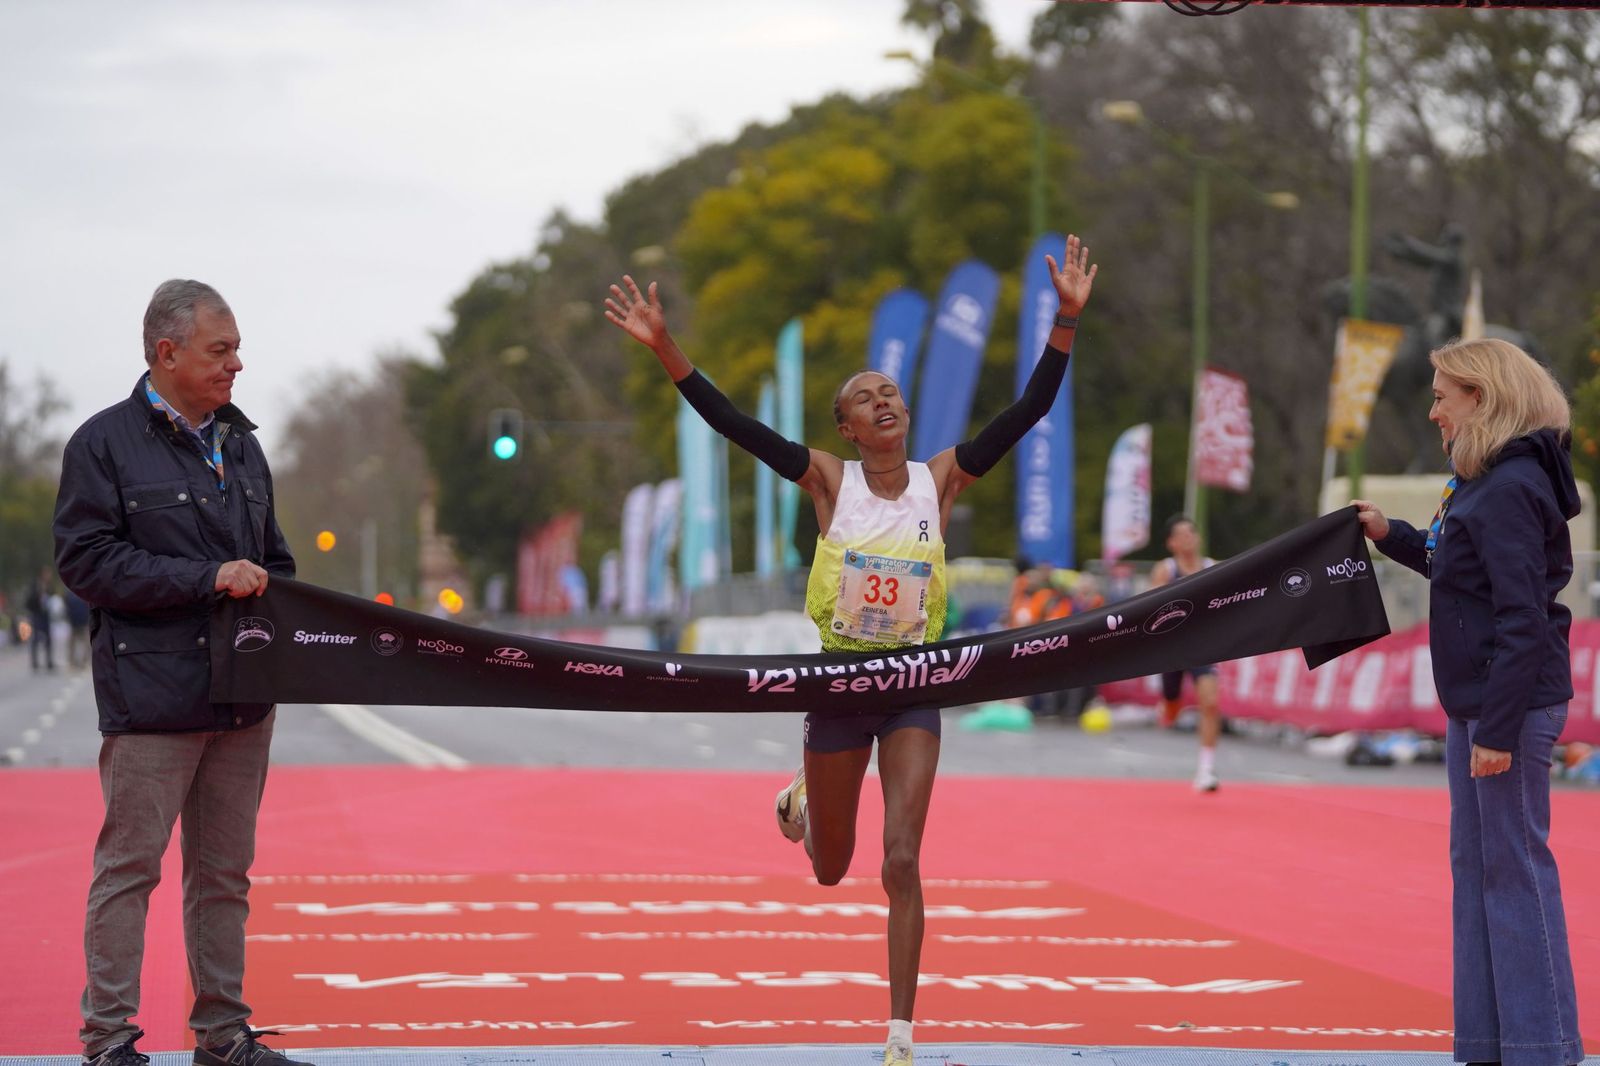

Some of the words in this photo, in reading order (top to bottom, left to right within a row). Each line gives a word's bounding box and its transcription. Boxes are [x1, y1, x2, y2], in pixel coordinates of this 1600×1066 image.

[864, 575, 899, 606] 33
[1208, 586, 1267, 611] Sprinter
[862, 606, 887, 616] ZEINEBA
[293, 629, 357, 646] Sprinter
[1010, 635, 1069, 658] HOKA
[485, 657, 534, 669] HYUNDAI
[564, 661, 624, 677] HOKA
[829, 663, 952, 693] sevilla
